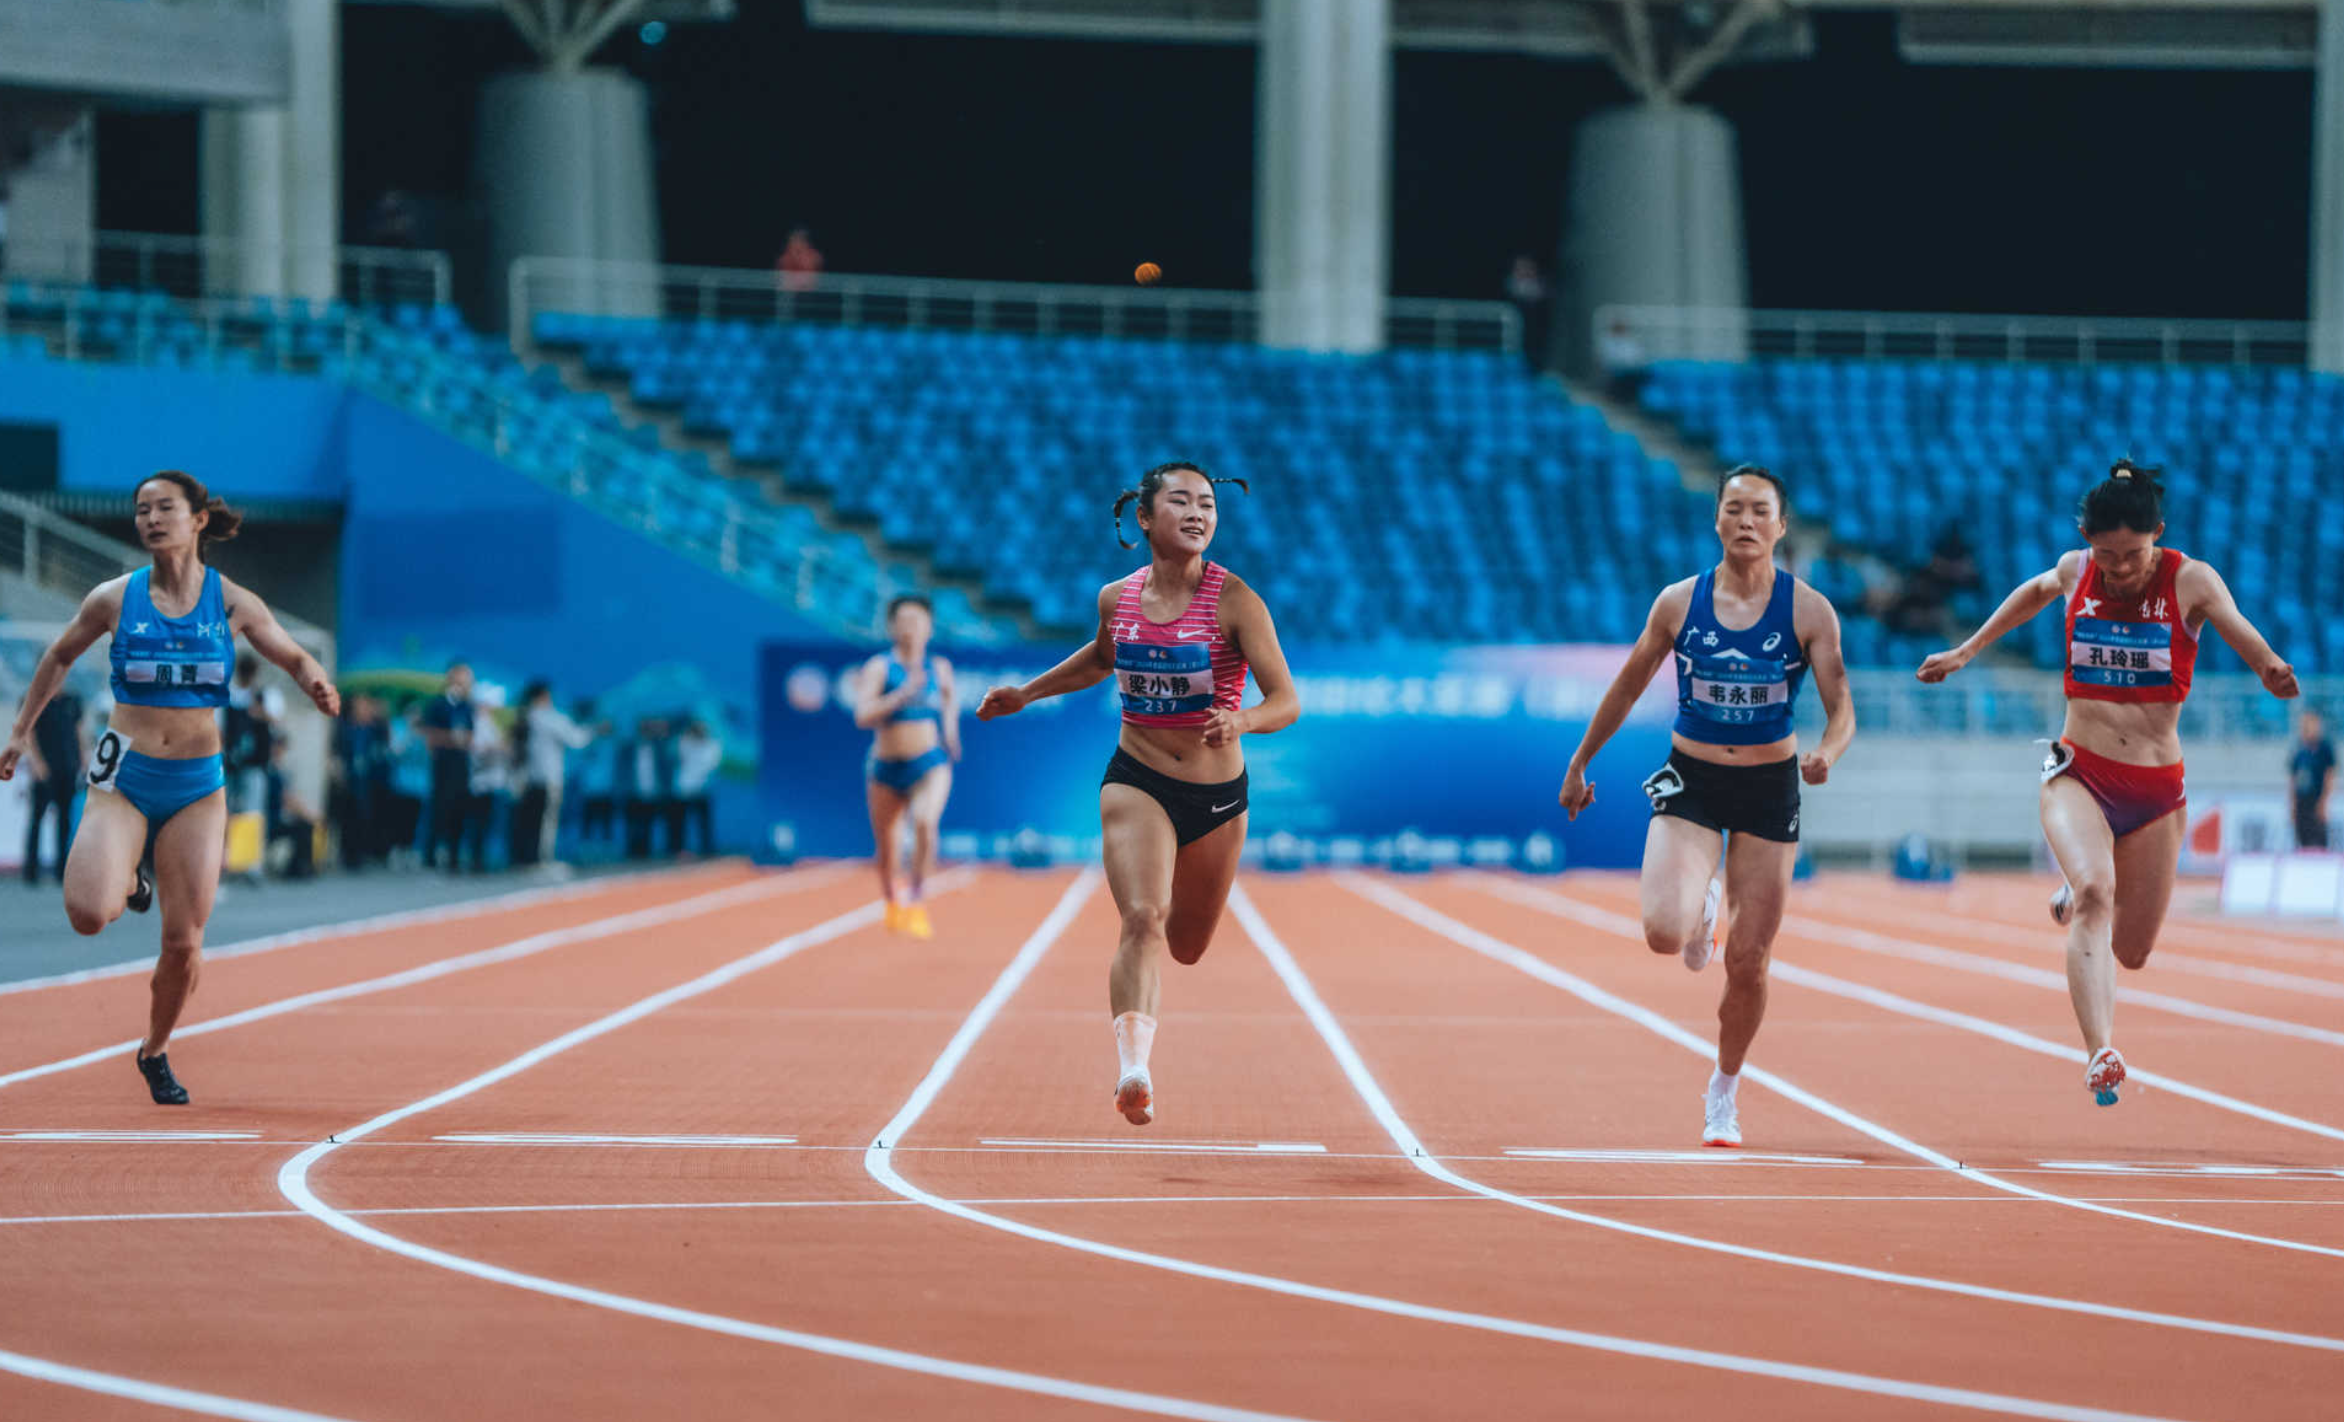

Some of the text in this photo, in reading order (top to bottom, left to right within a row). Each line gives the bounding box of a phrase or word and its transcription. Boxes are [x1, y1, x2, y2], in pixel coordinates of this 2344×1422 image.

[1683, 626, 1719, 647] 广西
[1129, 674, 1190, 696] 梁小静
[2104, 671, 2136, 684] 510
[1708, 684, 1769, 705] 韦永丽
[1145, 699, 1177, 712] 237
[1722, 709, 1754, 722] 257
[89, 731, 121, 784] 9
